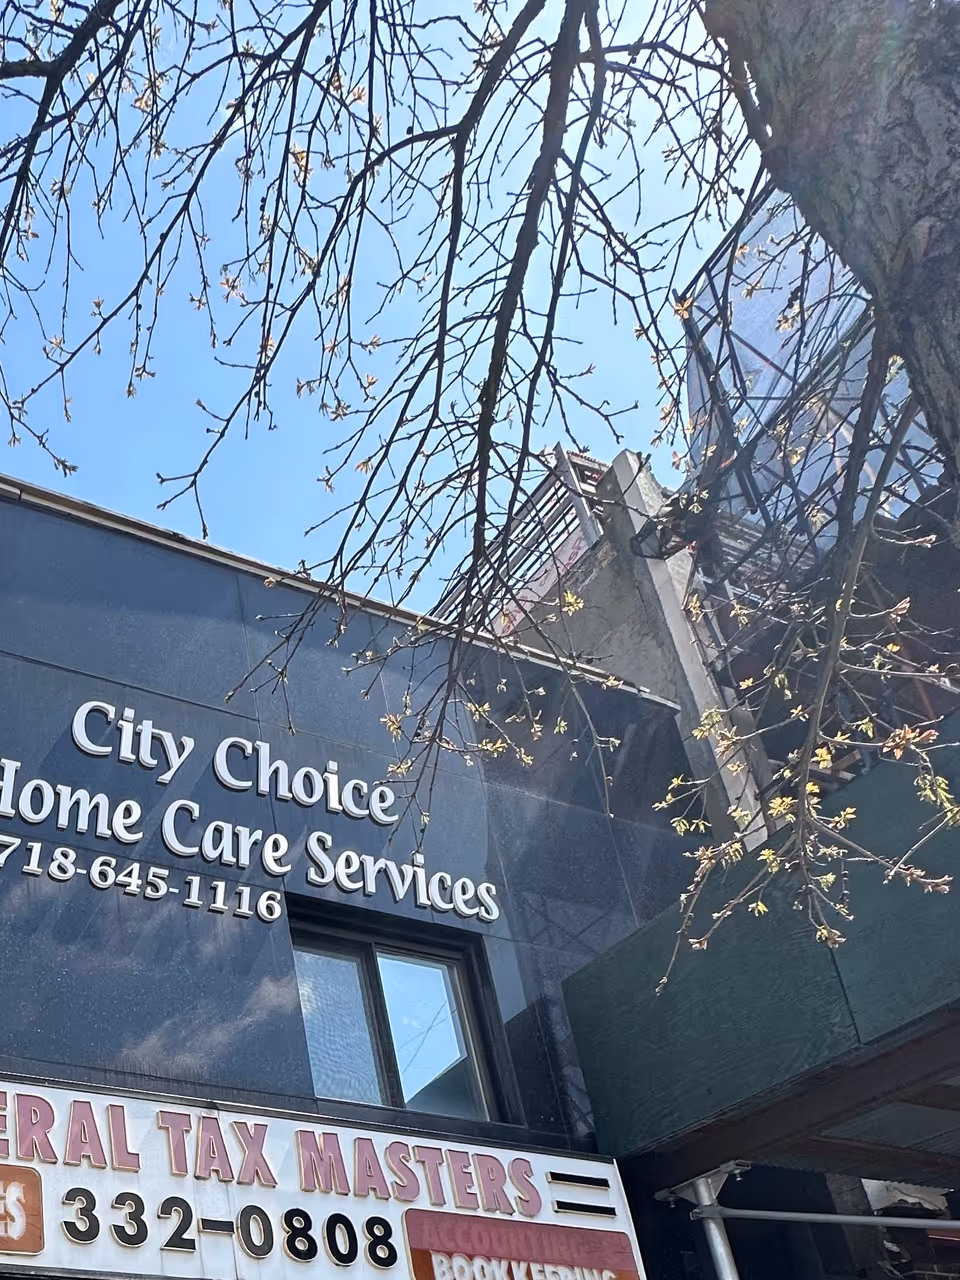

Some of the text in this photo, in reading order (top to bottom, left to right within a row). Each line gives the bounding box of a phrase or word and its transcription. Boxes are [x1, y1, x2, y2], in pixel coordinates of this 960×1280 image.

[71, 700, 399, 825] City Choice
[162, 799, 292, 876] Care
[306, 831, 500, 922] Services
[156, 1110, 279, 1188] TAX
[296, 1129, 542, 1217] MASTERS
[61, 1187, 398, 1270] 332-0808
